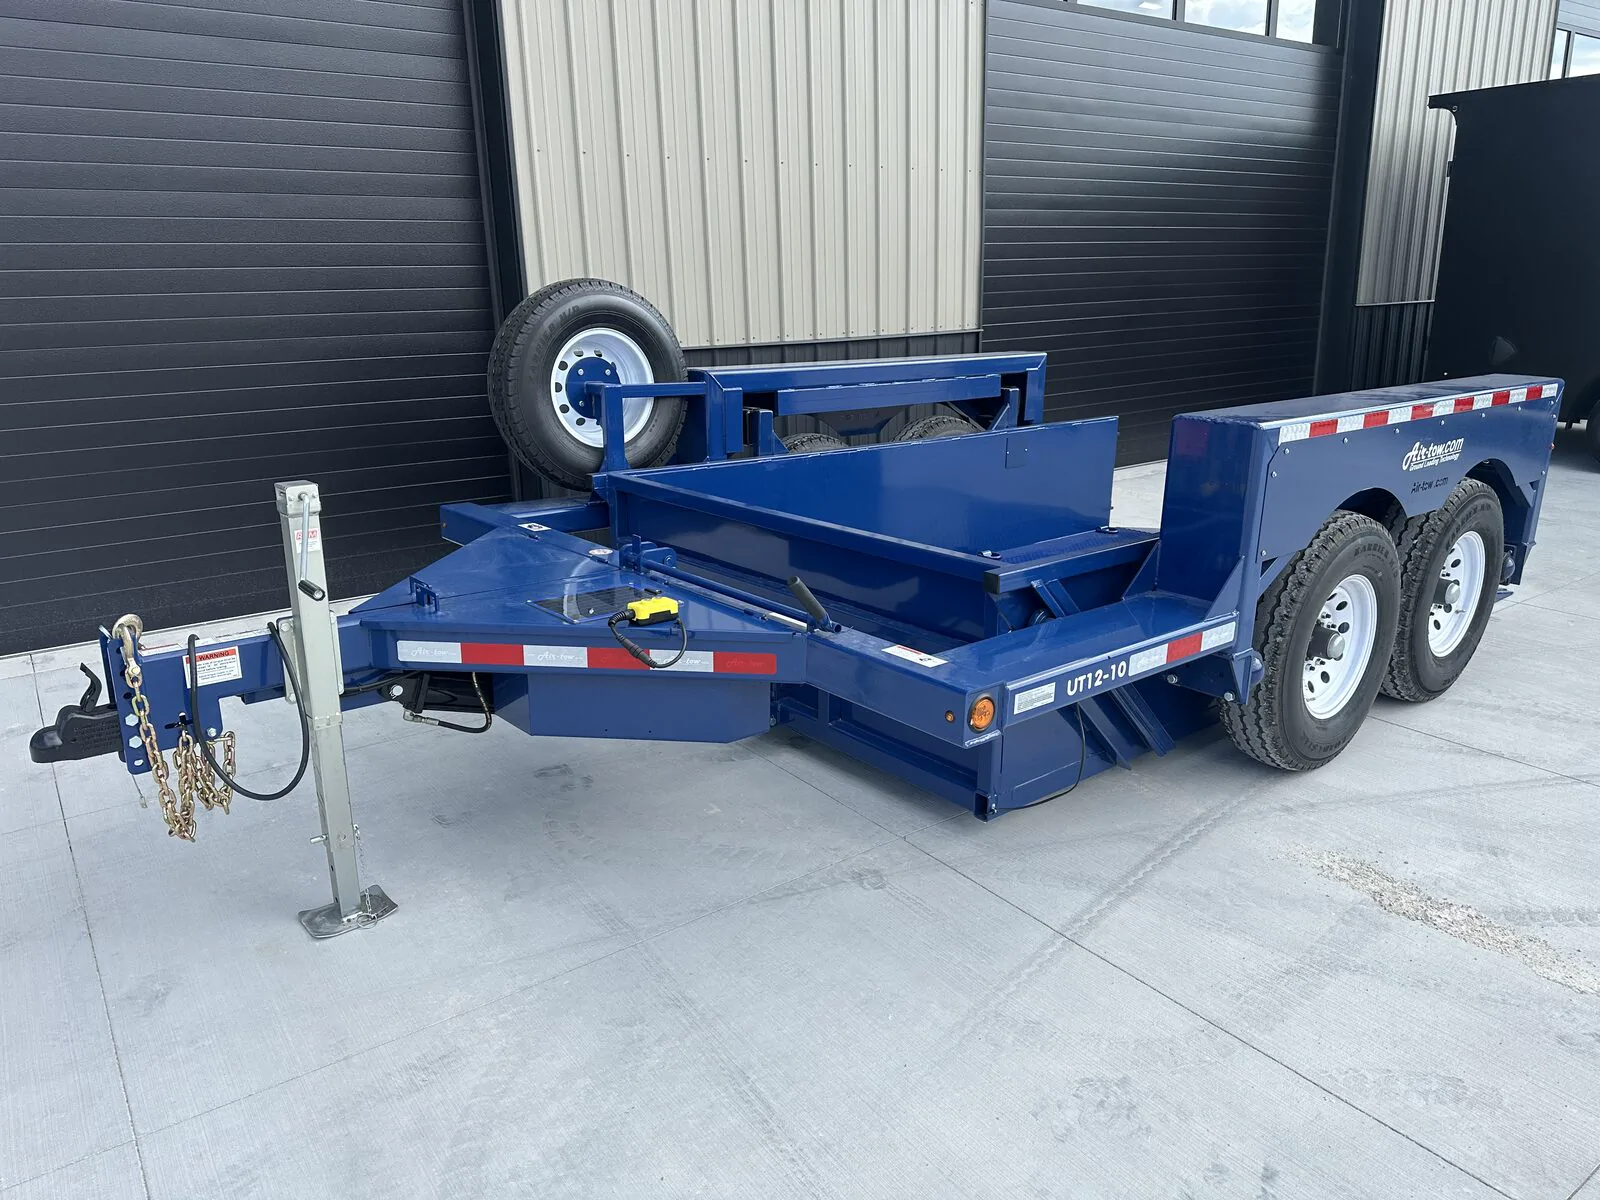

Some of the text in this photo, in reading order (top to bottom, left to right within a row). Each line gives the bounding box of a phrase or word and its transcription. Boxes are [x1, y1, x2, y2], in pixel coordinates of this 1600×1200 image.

[1402, 438, 1464, 470] Air-tow.com
[296, 529, 318, 541] RM
[198, 650, 230, 662] WARNING
[1067, 660, 1127, 696] UT12-10
